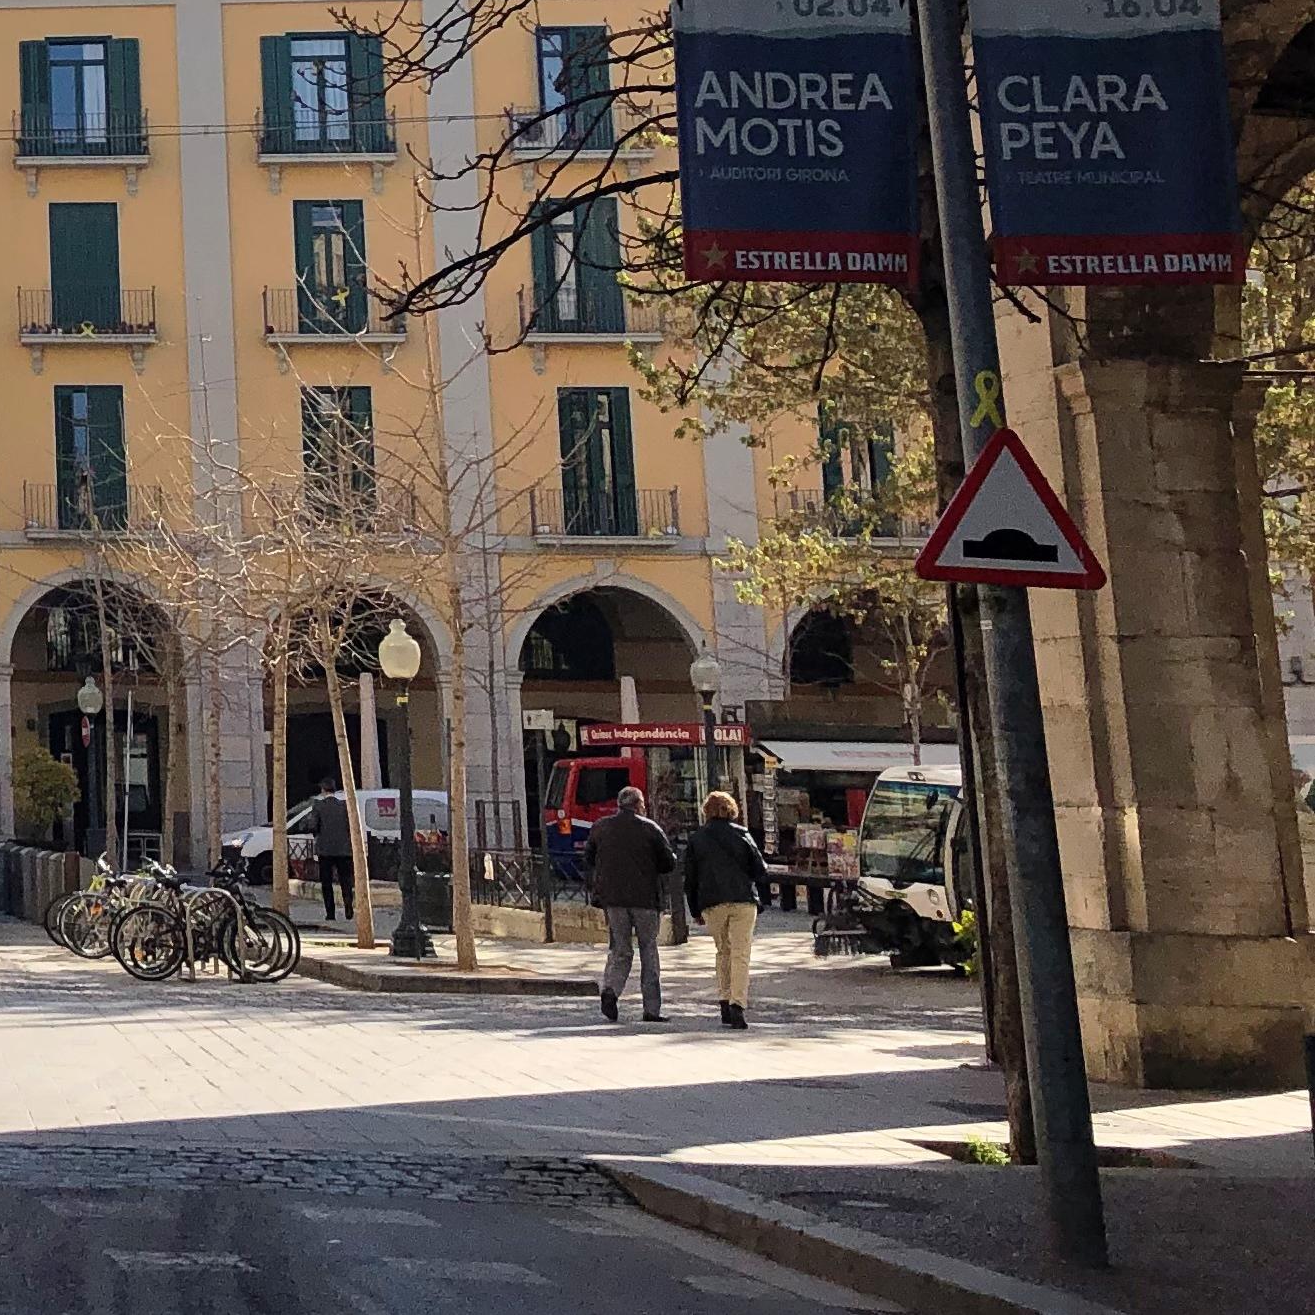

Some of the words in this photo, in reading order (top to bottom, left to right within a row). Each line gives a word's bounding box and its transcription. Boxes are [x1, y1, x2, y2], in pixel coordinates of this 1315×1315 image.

[694, 71, 892, 111] ANDREA
[997, 74, 1169, 113] CLARA
[695, 117, 844, 157] MOTIS
[1000, 121, 1126, 160] PEYA
[709, 166, 782, 182] AUDITORI
[785, 168, 851, 183] GIRONA
[734, 249, 843, 273] ESTRELLA
[847, 252, 908, 274] DAMM
[1046, 254, 1159, 275] ESTRELLA
[1163, 253, 1233, 274] DAMM
